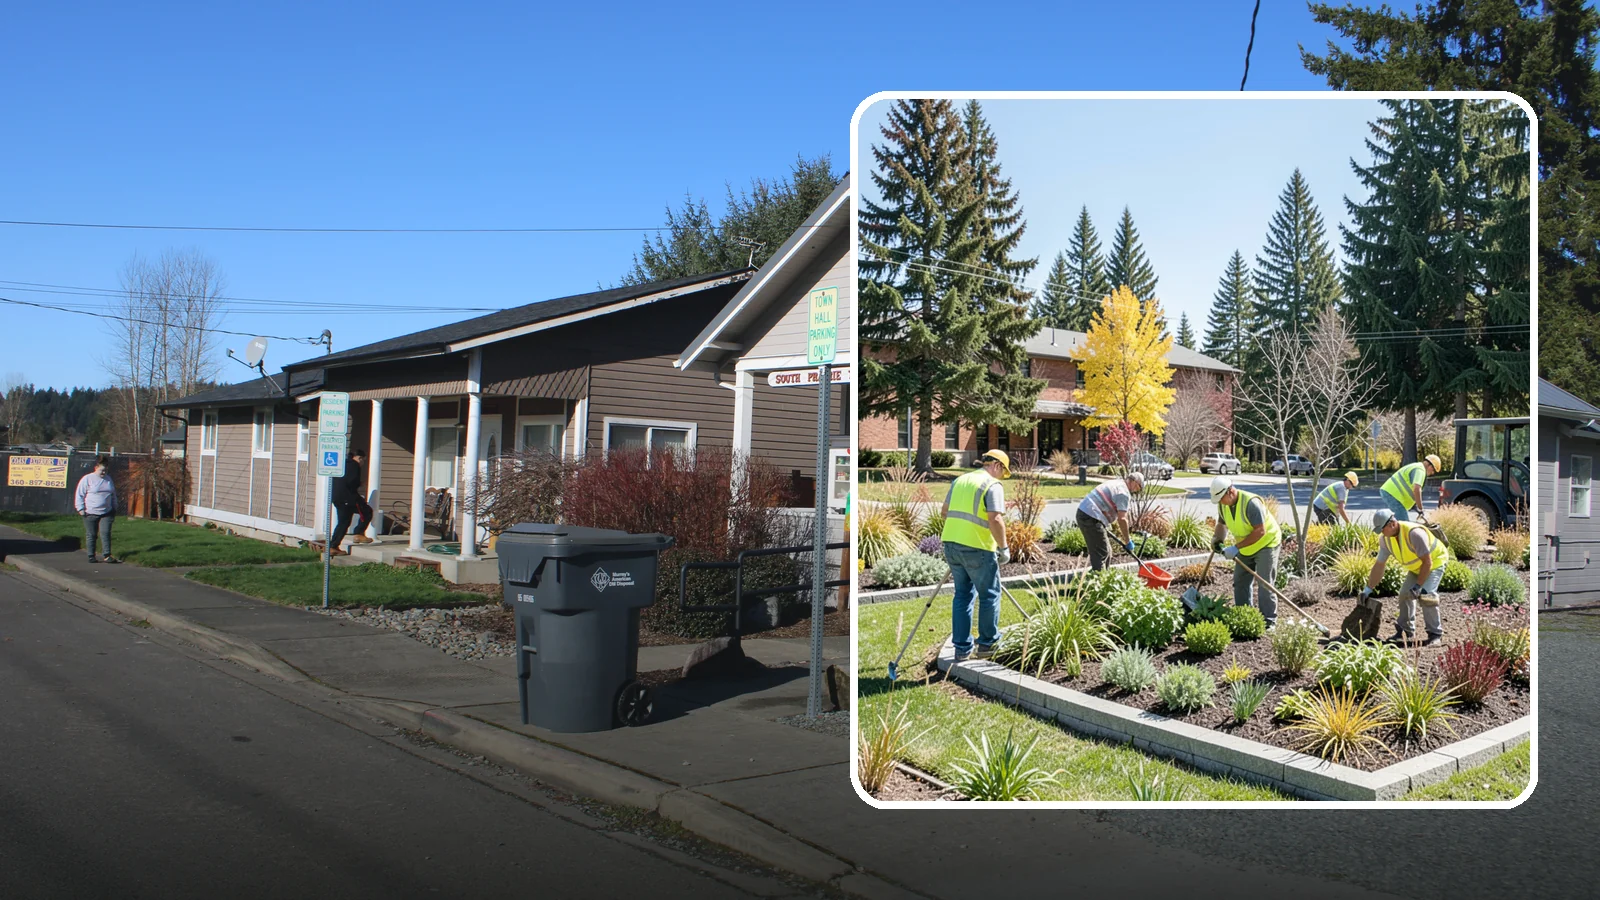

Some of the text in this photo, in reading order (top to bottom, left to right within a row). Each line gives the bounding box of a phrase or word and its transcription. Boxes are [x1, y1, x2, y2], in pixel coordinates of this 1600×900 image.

[815, 295, 833, 308] TOWN
[814, 311, 831, 324] HALL
[810, 326, 836, 341] PARKING
[813, 344, 831, 357] ONLY
[775, 373, 801, 384] SOUTH
[807, 370, 842, 382] PRIE
